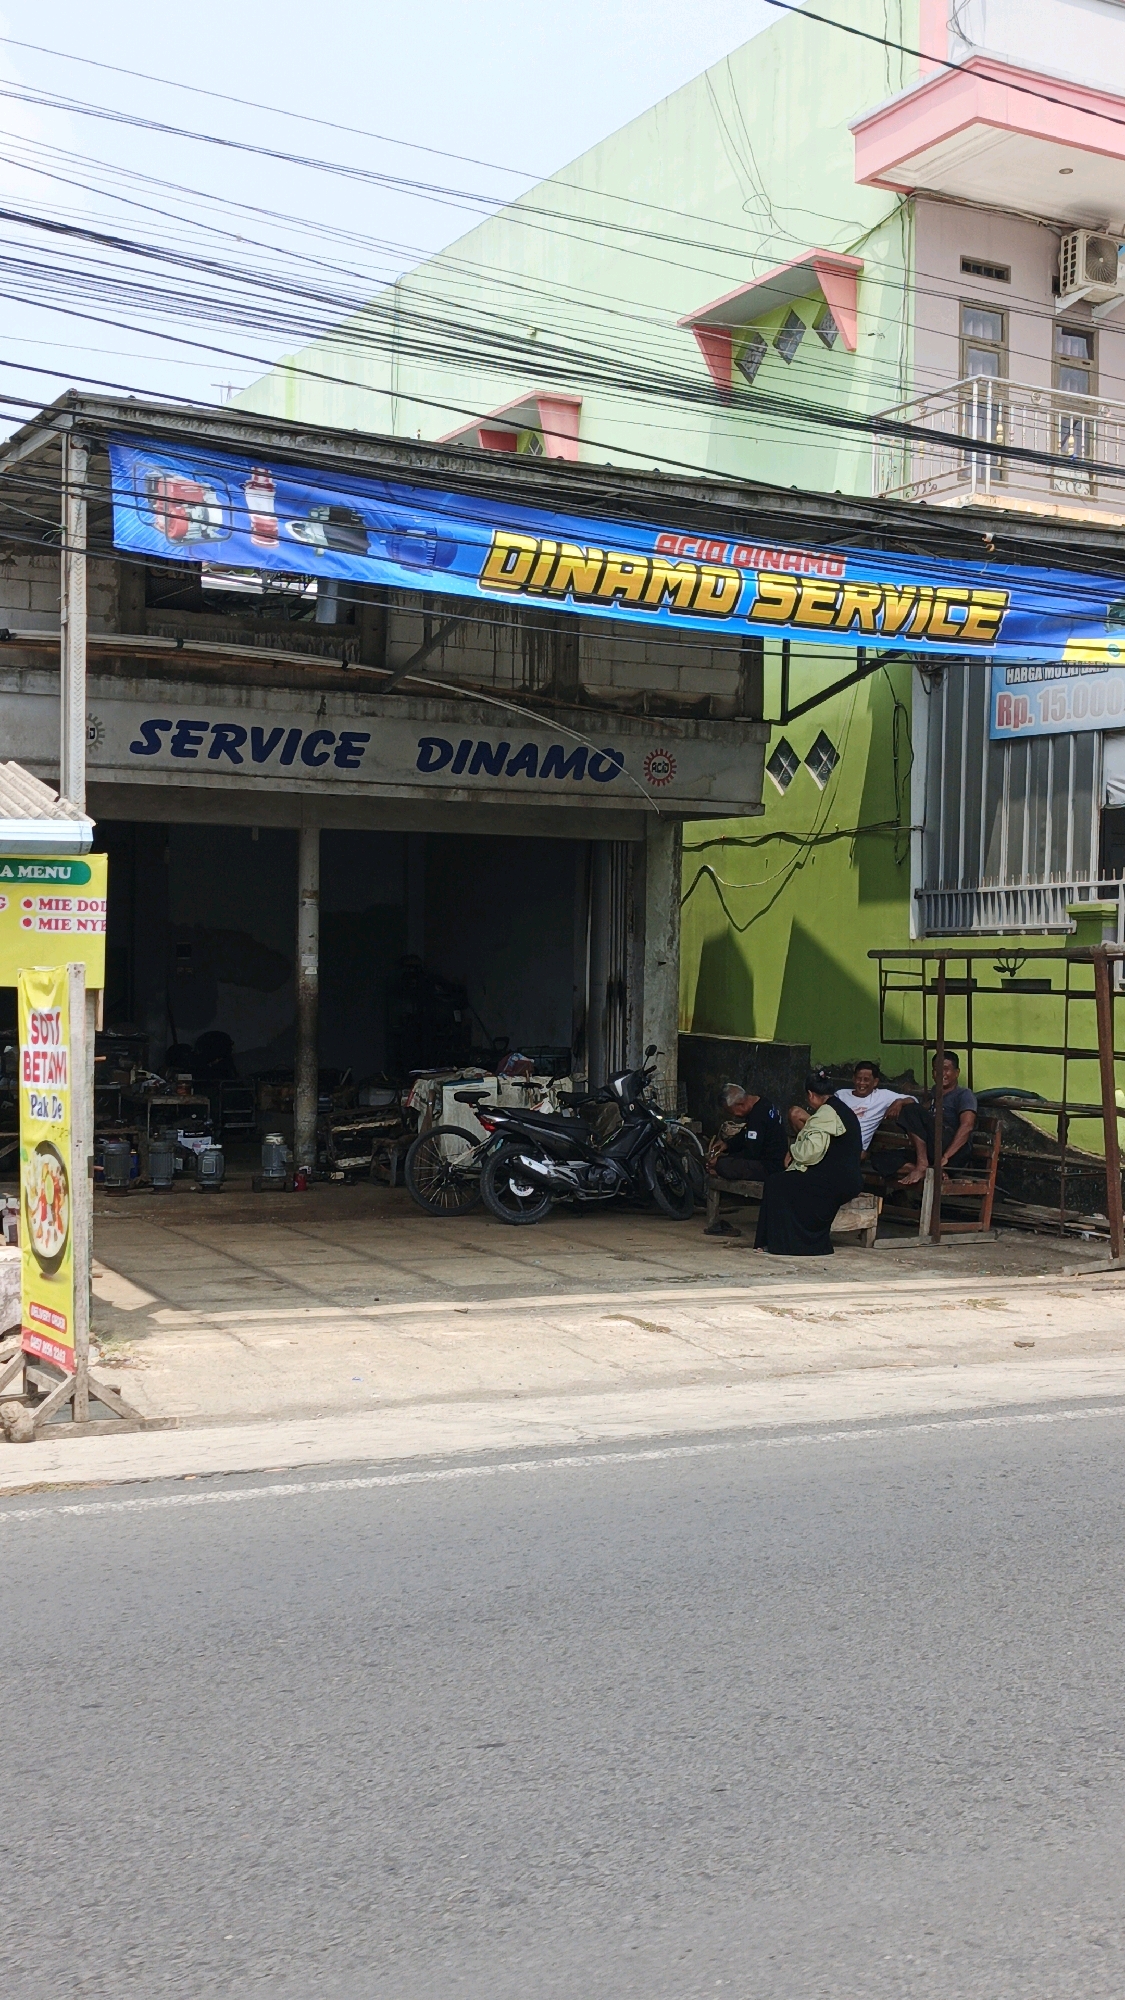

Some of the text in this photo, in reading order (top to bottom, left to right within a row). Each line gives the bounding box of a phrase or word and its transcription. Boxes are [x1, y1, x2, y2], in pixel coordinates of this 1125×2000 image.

[656, 533, 845, 577] ACID DINAMO
[480, 530, 1009, 646] DINAMO SERVICE
[1006, 667, 1043, 685] HARGA
[997, 693, 1033, 729] Rp.
[129, 719, 624, 782] SERVICE DINAMO
[17, 865, 72, 879] MENU
[38, 898, 72, 911] MIE
[38, 918, 72, 931] MIE
[30, 1094, 62, 1119] Pak De
